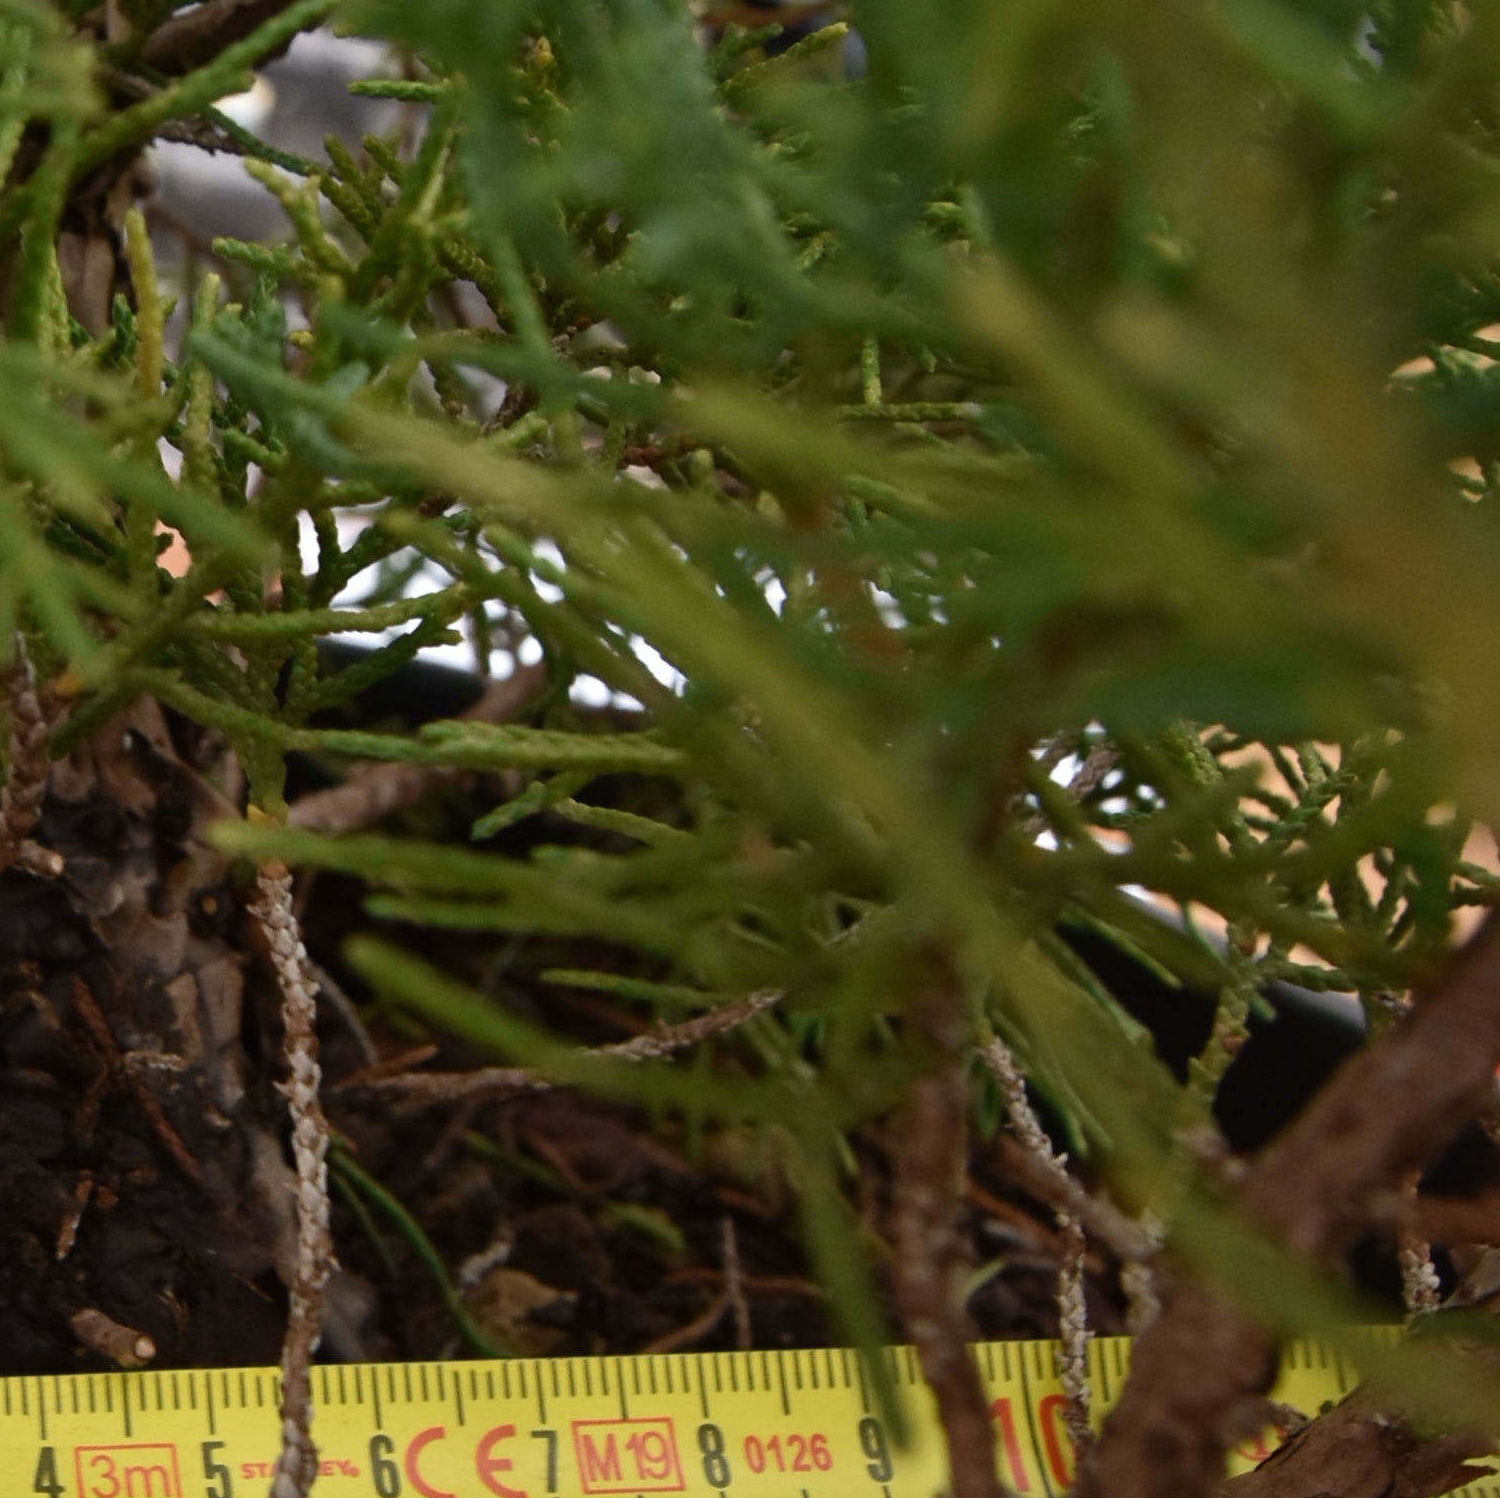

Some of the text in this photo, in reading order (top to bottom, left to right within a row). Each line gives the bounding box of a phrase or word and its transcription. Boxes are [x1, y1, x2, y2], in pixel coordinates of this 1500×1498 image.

[531, 1430, 557, 1493] 7
[696, 1424, 728, 1489] 8
[744, 1433, 833, 1474] 0126
[858, 1417, 893, 1484] 9
